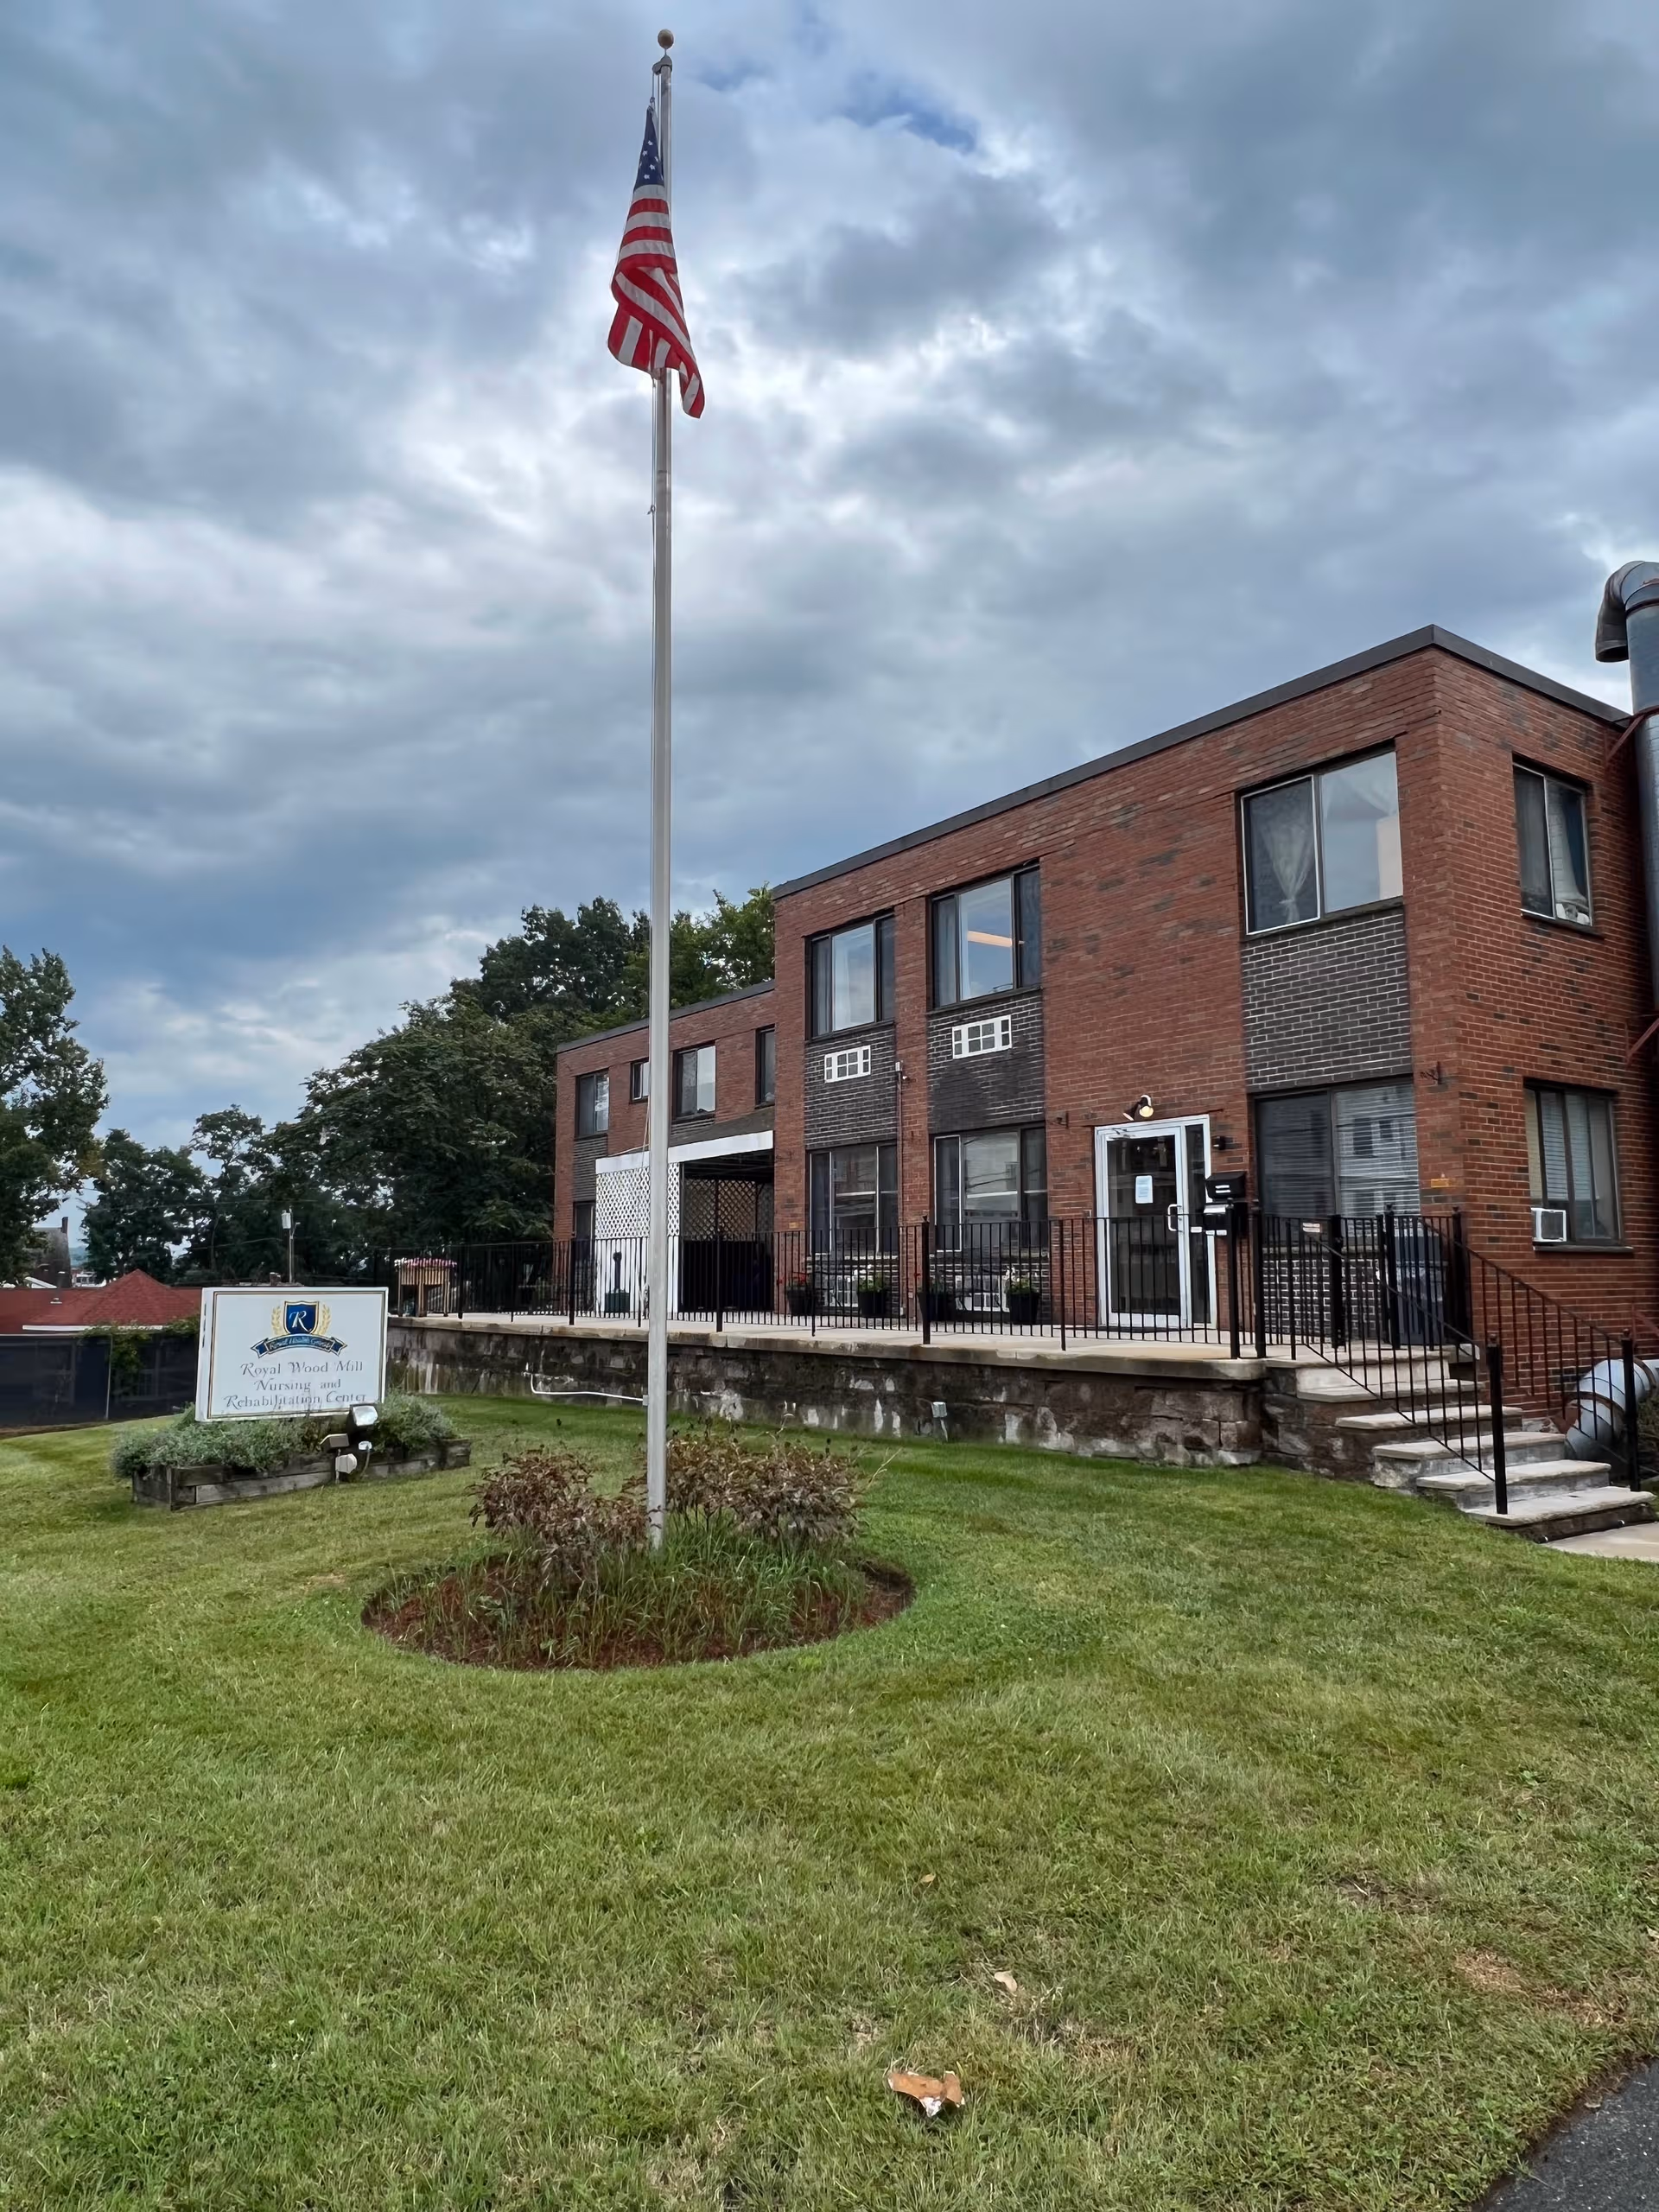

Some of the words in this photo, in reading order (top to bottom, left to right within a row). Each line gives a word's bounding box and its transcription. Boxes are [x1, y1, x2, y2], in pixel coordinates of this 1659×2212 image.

[289, 1310, 312, 1332] R
[240, 1362, 281, 1378] Royal
[288, 1361, 328, 1373] Wood
[335, 1360, 363, 1372] Mill
[254, 1378, 311, 1392] Nursing
[320, 1379, 341, 1389] and
[224, 1393, 321, 1409] Rehabilitation
[326, 1390, 366, 1403] Center
